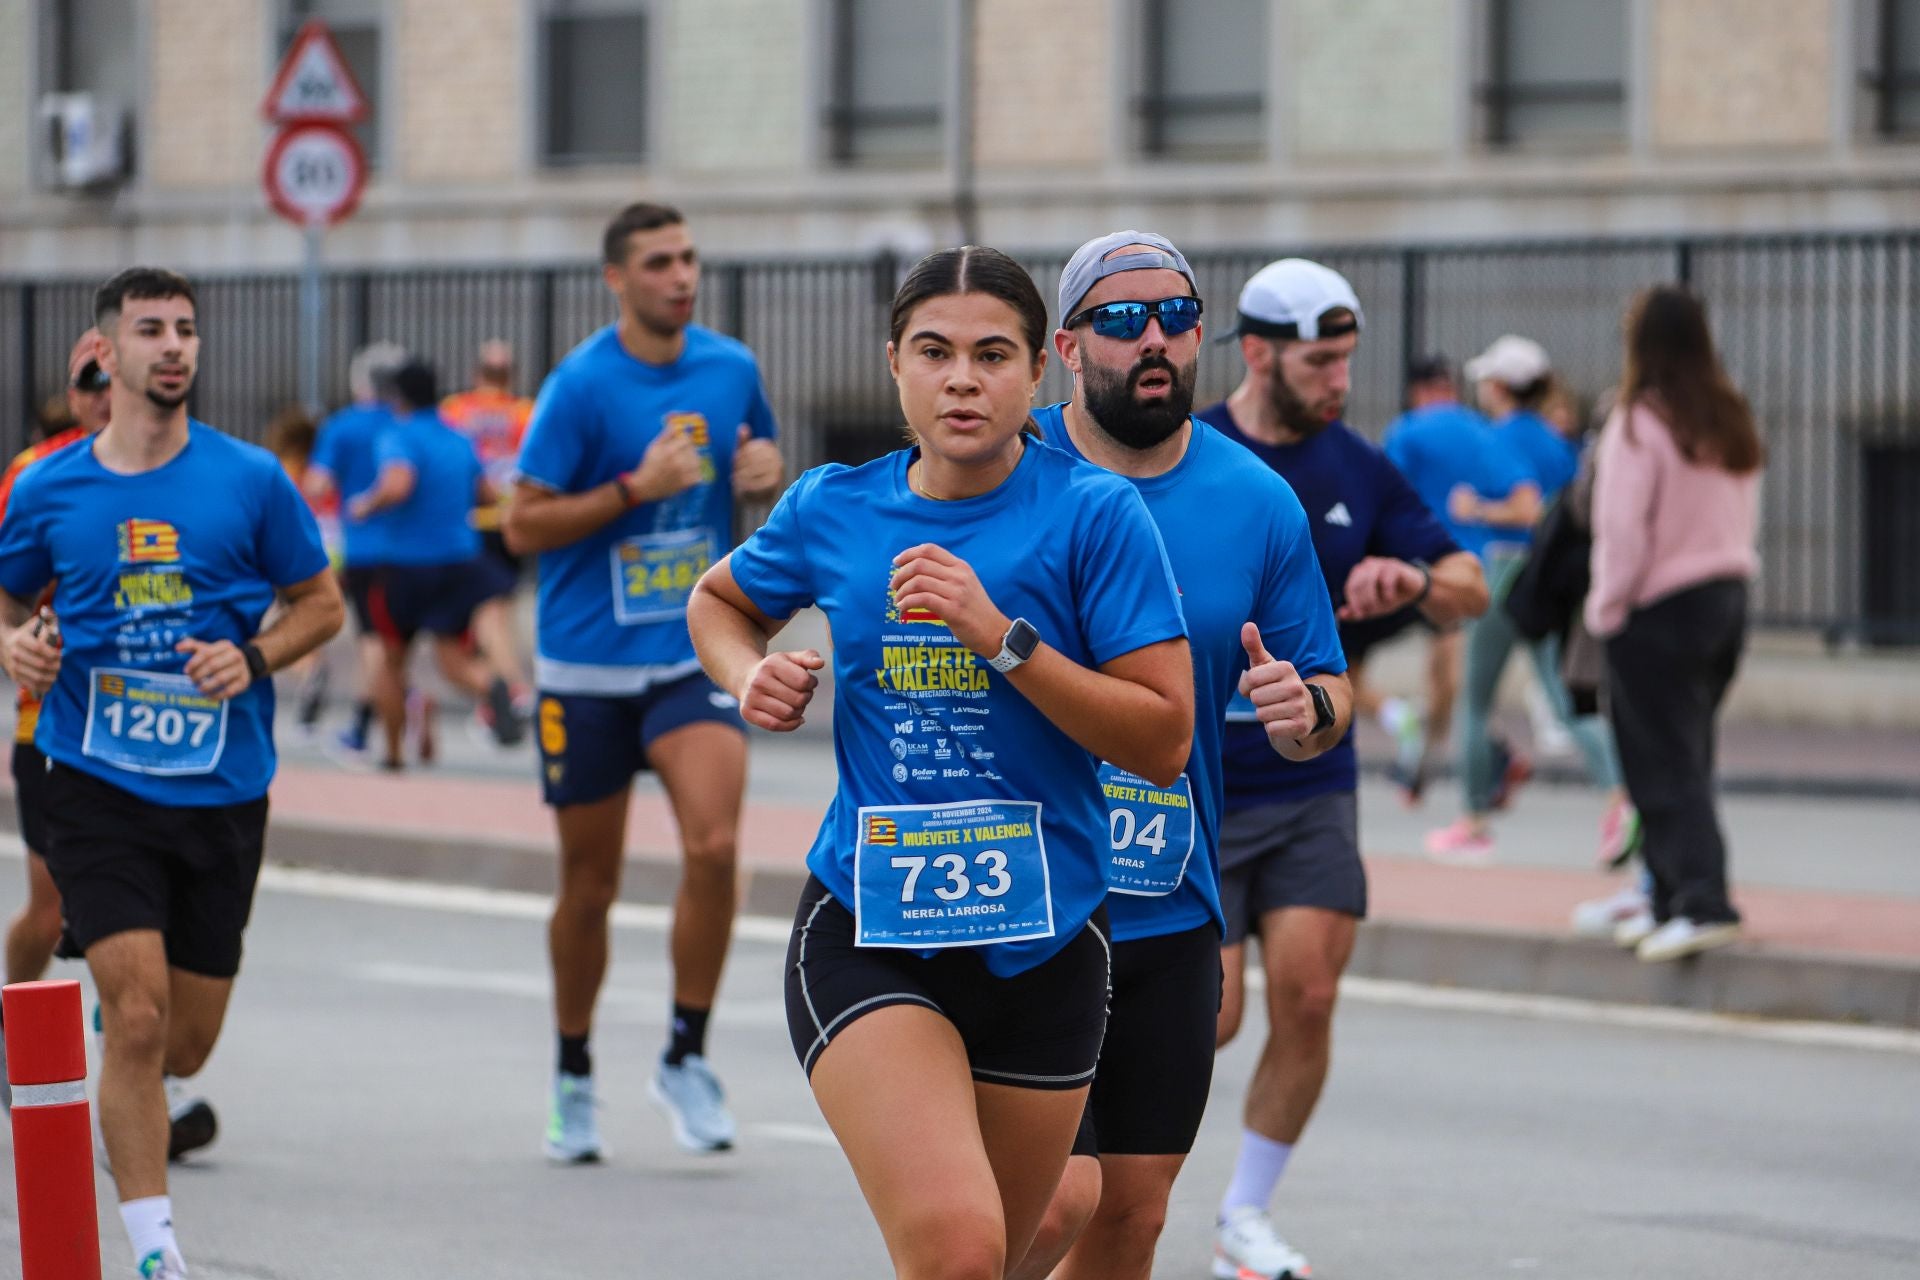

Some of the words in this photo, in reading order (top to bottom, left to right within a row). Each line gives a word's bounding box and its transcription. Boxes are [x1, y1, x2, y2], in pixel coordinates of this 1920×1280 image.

[882, 642, 976, 669] MUÉVETE
[890, 668, 990, 691] VALENCIA
[918, 690, 951, 698] AFECTADOS
[103, 701, 215, 748] 1207
[539, 697, 566, 756] 6
[943, 768, 970, 778] Hero
[1138, 789, 1147, 802] X
[1148, 790, 1188, 808] VALENCIA
[942, 808, 976, 818] NOVIEMBRE
[976, 806, 992, 814] 2024
[922, 819, 942, 827] CARRERA
[942, 818, 962, 826] POPULAR
[902, 828, 960, 847] MUÉVETE
[963, 828, 972, 844] X
[974, 822, 1033, 842] VALENCIA
[1112, 856, 1145, 869] ARRAS
[890, 849, 1013, 903] 733
[902, 908, 944, 920] NEREA
[947, 904, 1006, 918] LARROSA
